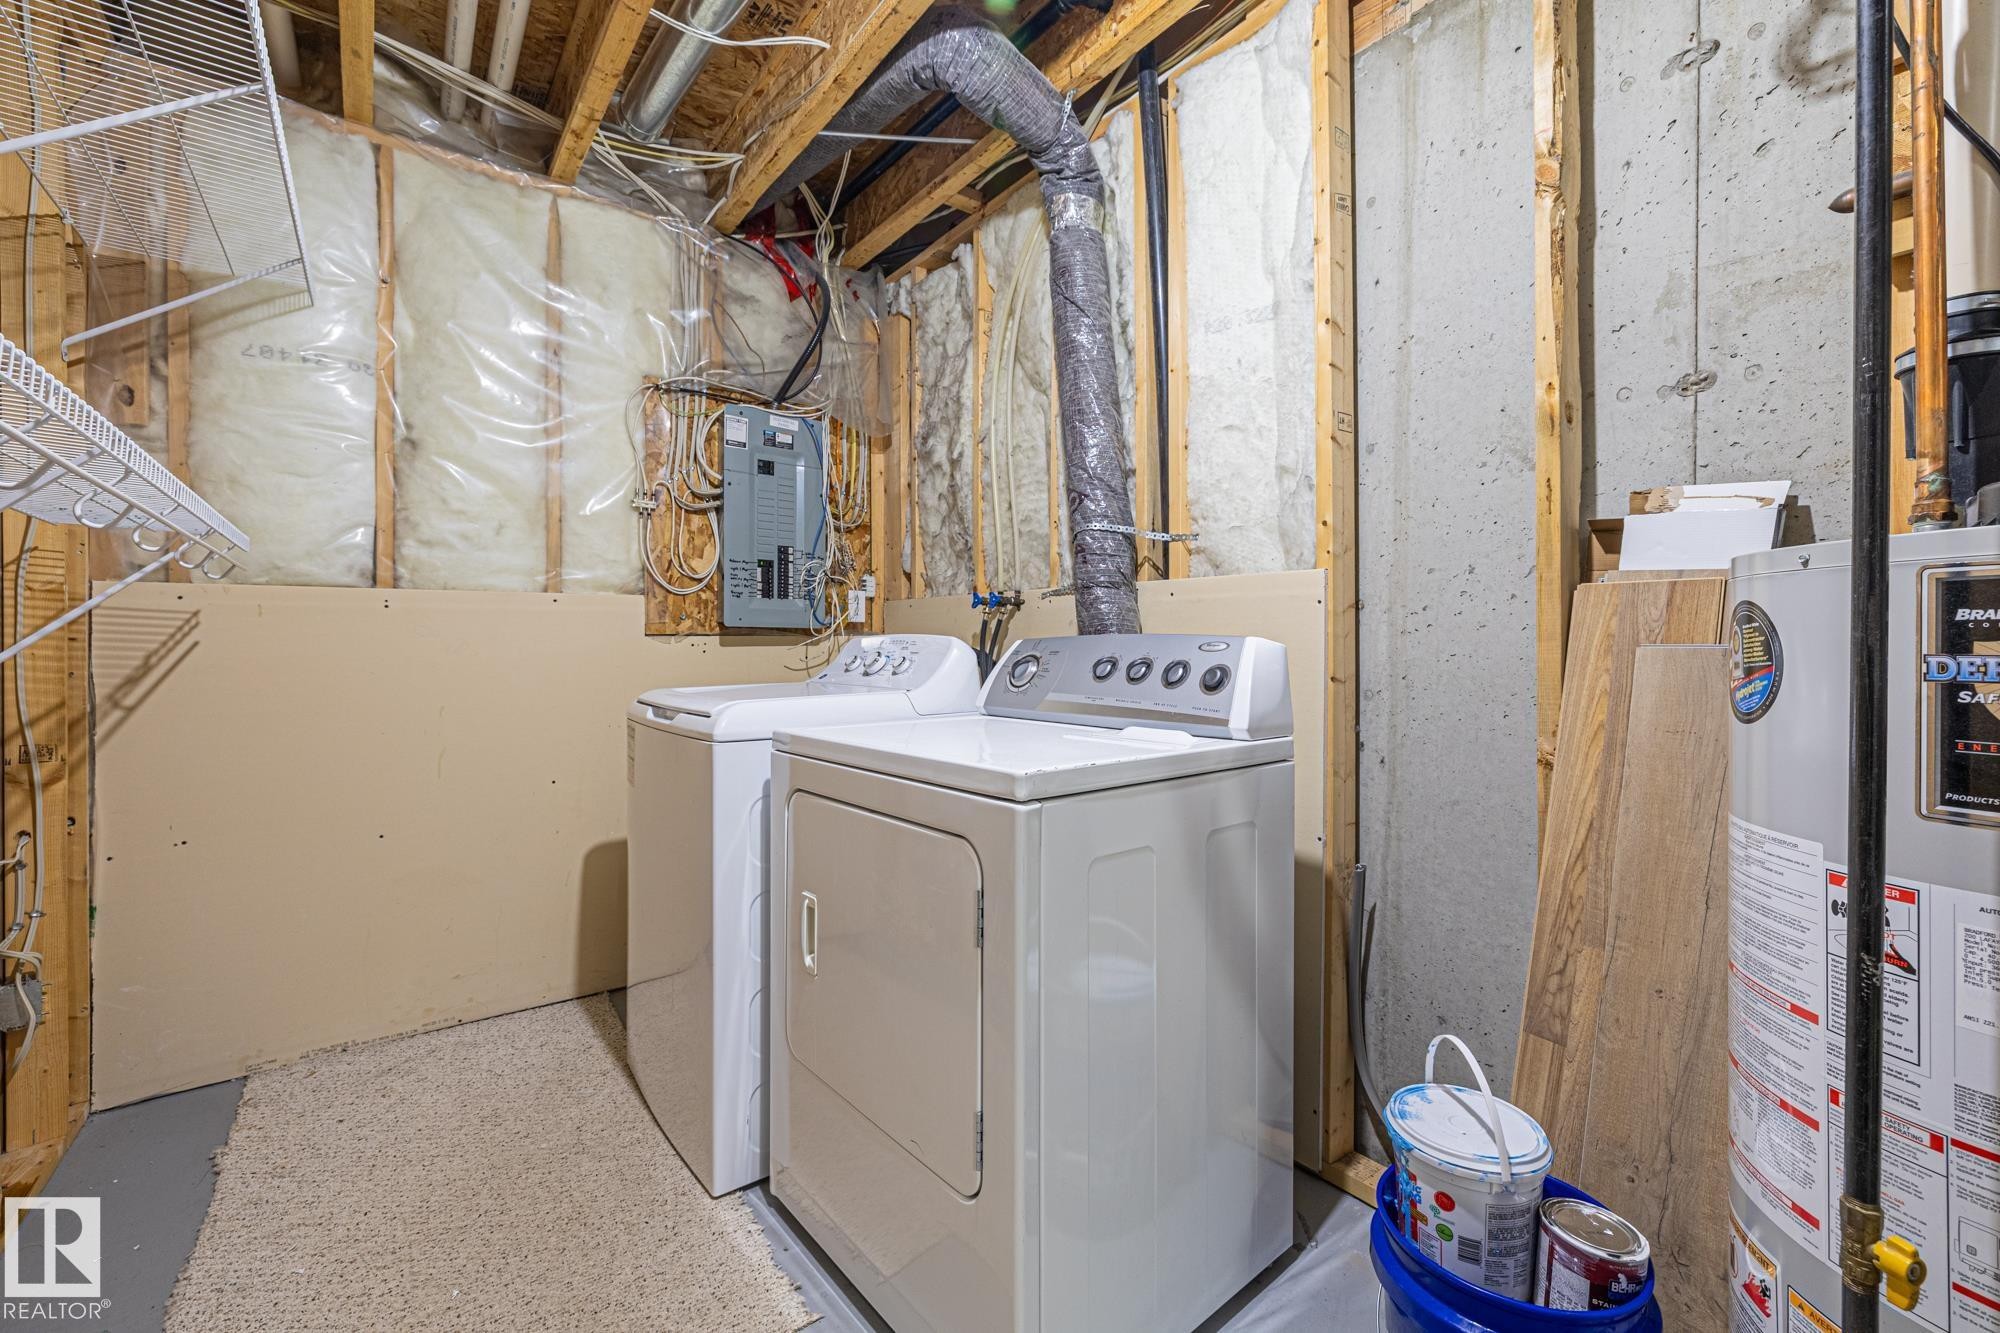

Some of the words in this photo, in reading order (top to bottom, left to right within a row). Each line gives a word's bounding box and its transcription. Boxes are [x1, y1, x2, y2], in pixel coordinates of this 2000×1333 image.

[1955, 608, 2000, 620] BRA
[1945, 793, 2000, 806] PRODUCTS
[1885, 957, 1909, 968] URN
[1884, 1116, 1910, 1130] SAFETY
[1884, 1121, 1923, 1143] OPERATING
